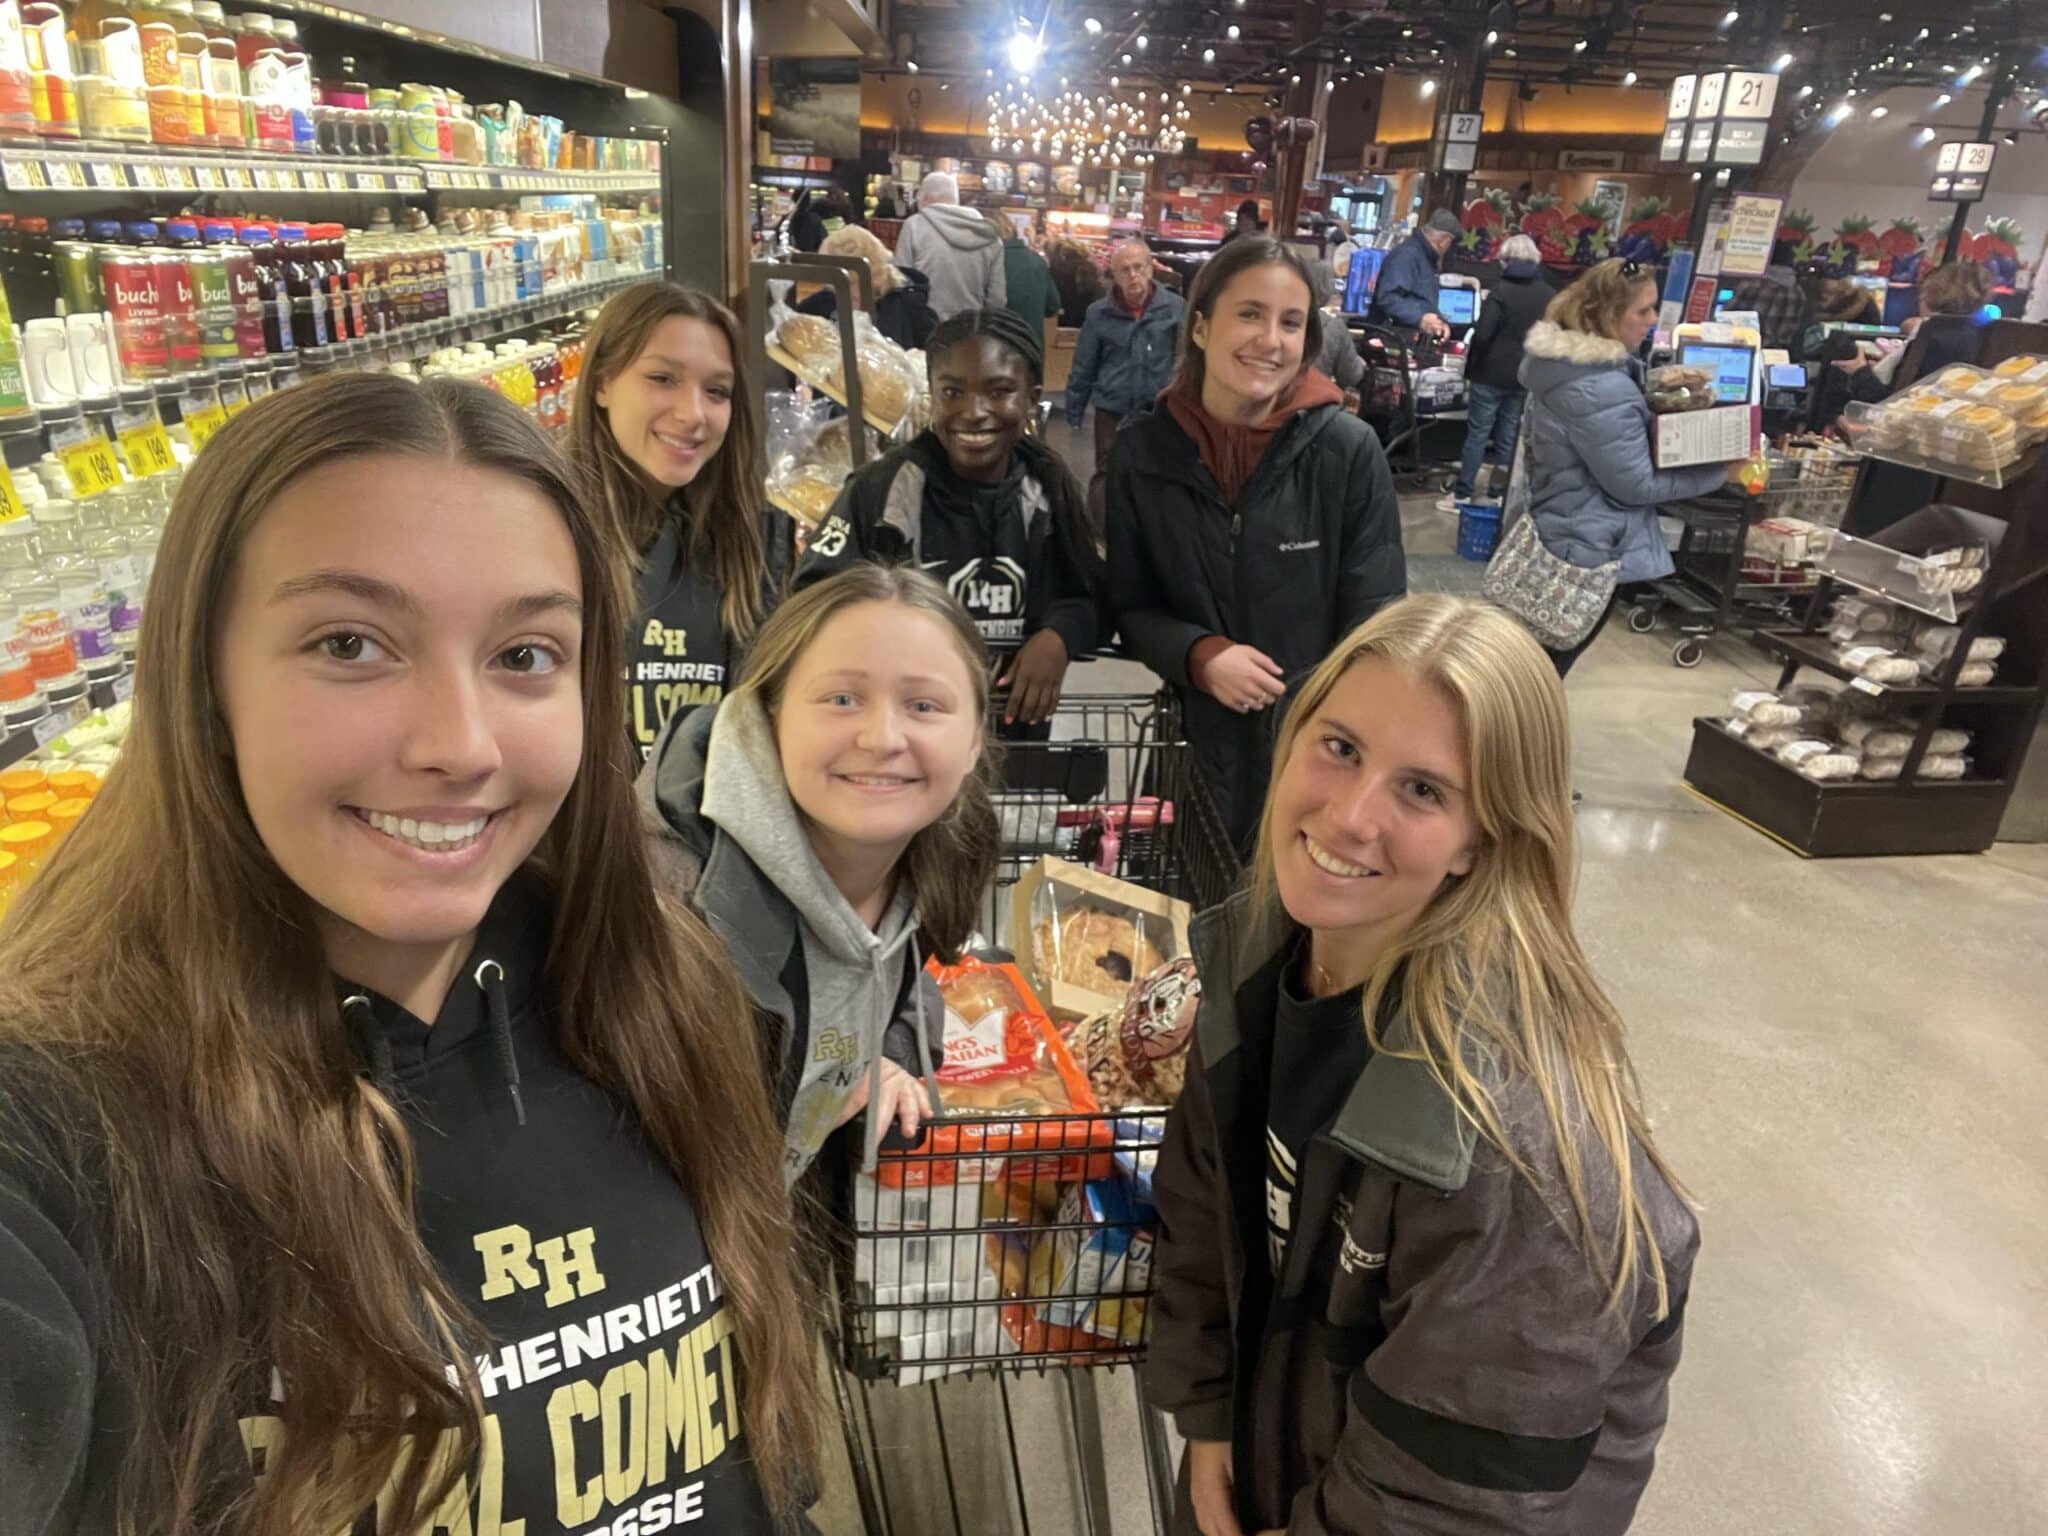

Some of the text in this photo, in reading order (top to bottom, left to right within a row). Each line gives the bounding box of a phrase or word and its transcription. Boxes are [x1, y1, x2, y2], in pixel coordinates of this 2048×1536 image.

[1739, 80, 1764, 106] 21
[1457, 117, 1474, 135] 27
[1969, 148, 1986, 164] 29
[236, 273, 258, 293] bu
[810, 526, 847, 557] 23
[643, 618, 686, 656] RH
[636, 662, 725, 682] HENRIET
[813, 1026, 860, 1066] RH
[473, 1224, 606, 1308] RH
[475, 1264, 722, 1398] HENRIETT
[546, 1308, 740, 1529] COMET
